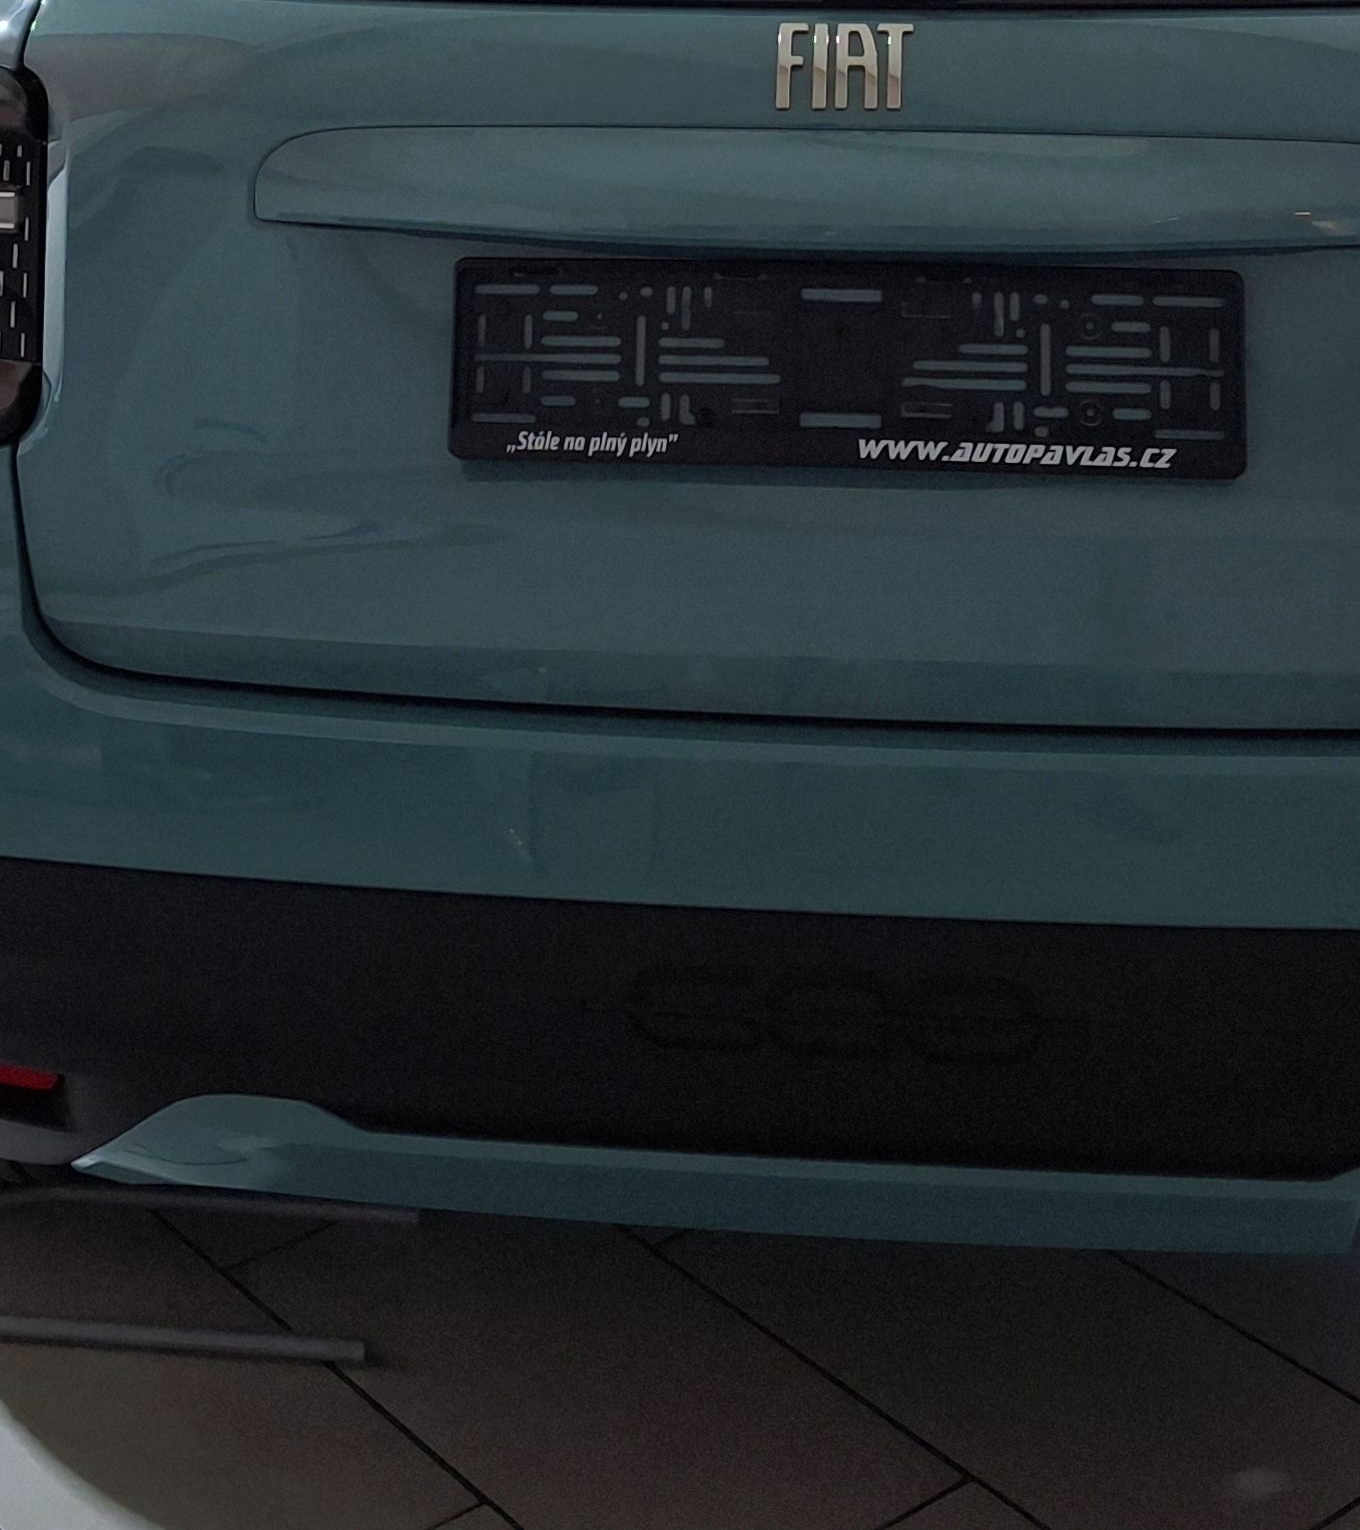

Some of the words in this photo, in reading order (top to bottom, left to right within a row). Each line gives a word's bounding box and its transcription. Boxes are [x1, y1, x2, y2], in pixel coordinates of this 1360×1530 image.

[775, 22, 915, 110] FIAT
[563, 434, 586, 452] na
[587, 431, 627, 457] plný
